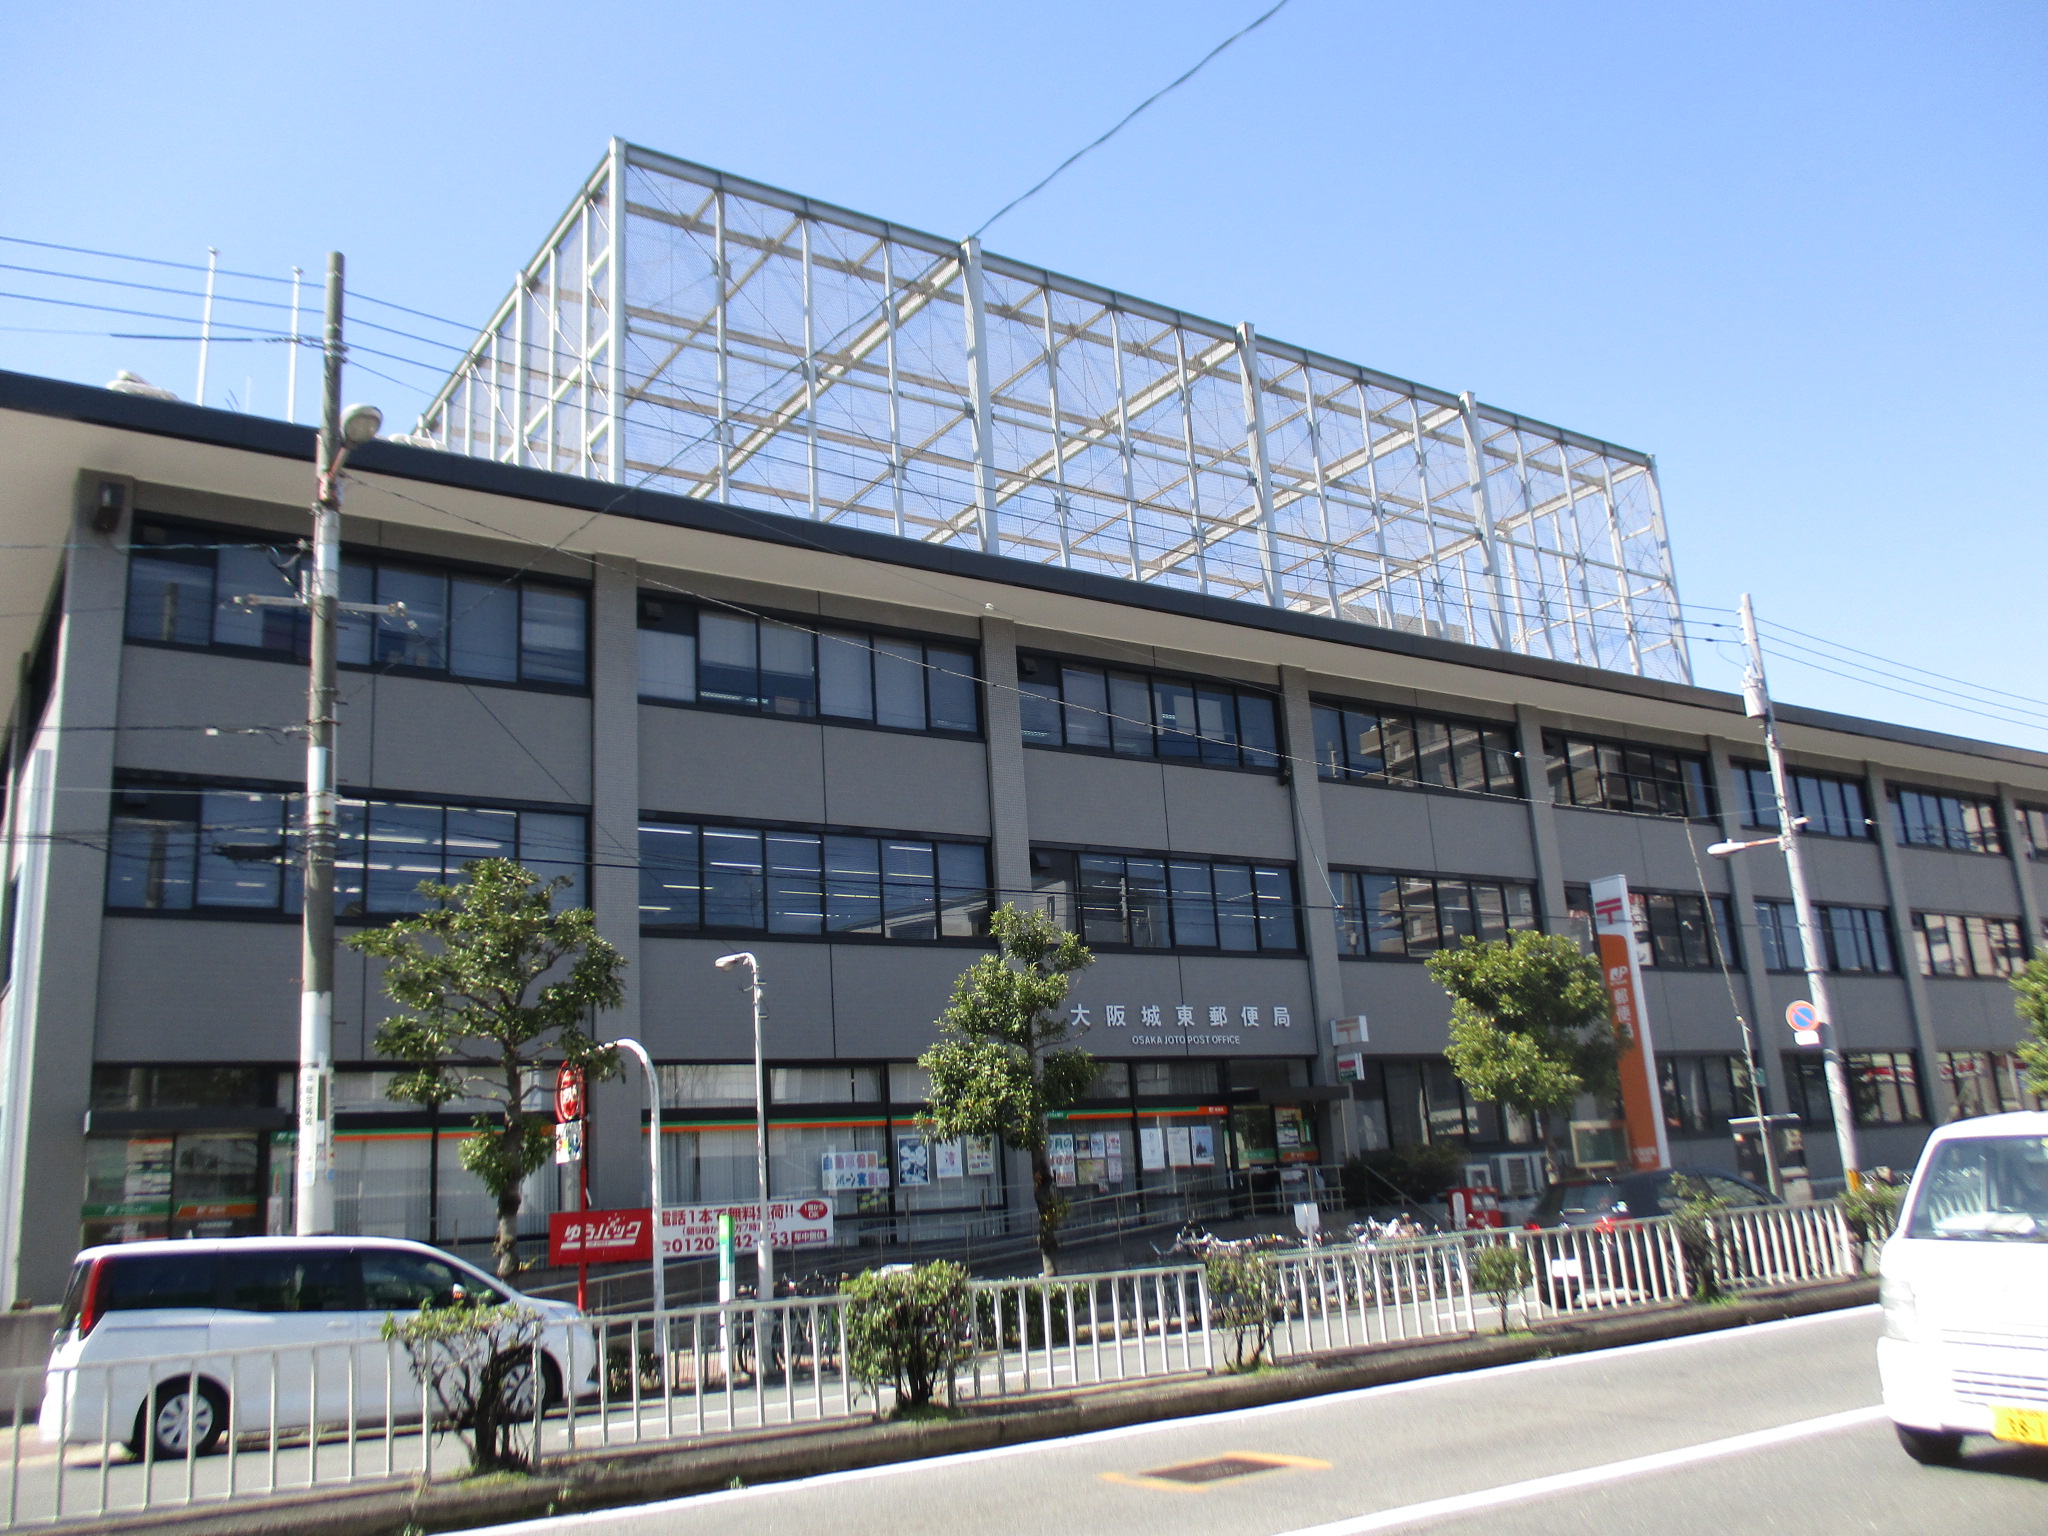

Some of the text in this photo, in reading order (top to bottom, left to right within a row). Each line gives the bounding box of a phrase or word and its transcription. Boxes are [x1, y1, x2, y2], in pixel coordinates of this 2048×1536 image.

[1070, 1004, 1291, 1027] 大阪城東郵便局
[1131, 1035, 1241, 1045] OSAKA JOTO POST OFFICE
[672, 1230, 789, 1252] 0120-42-53
